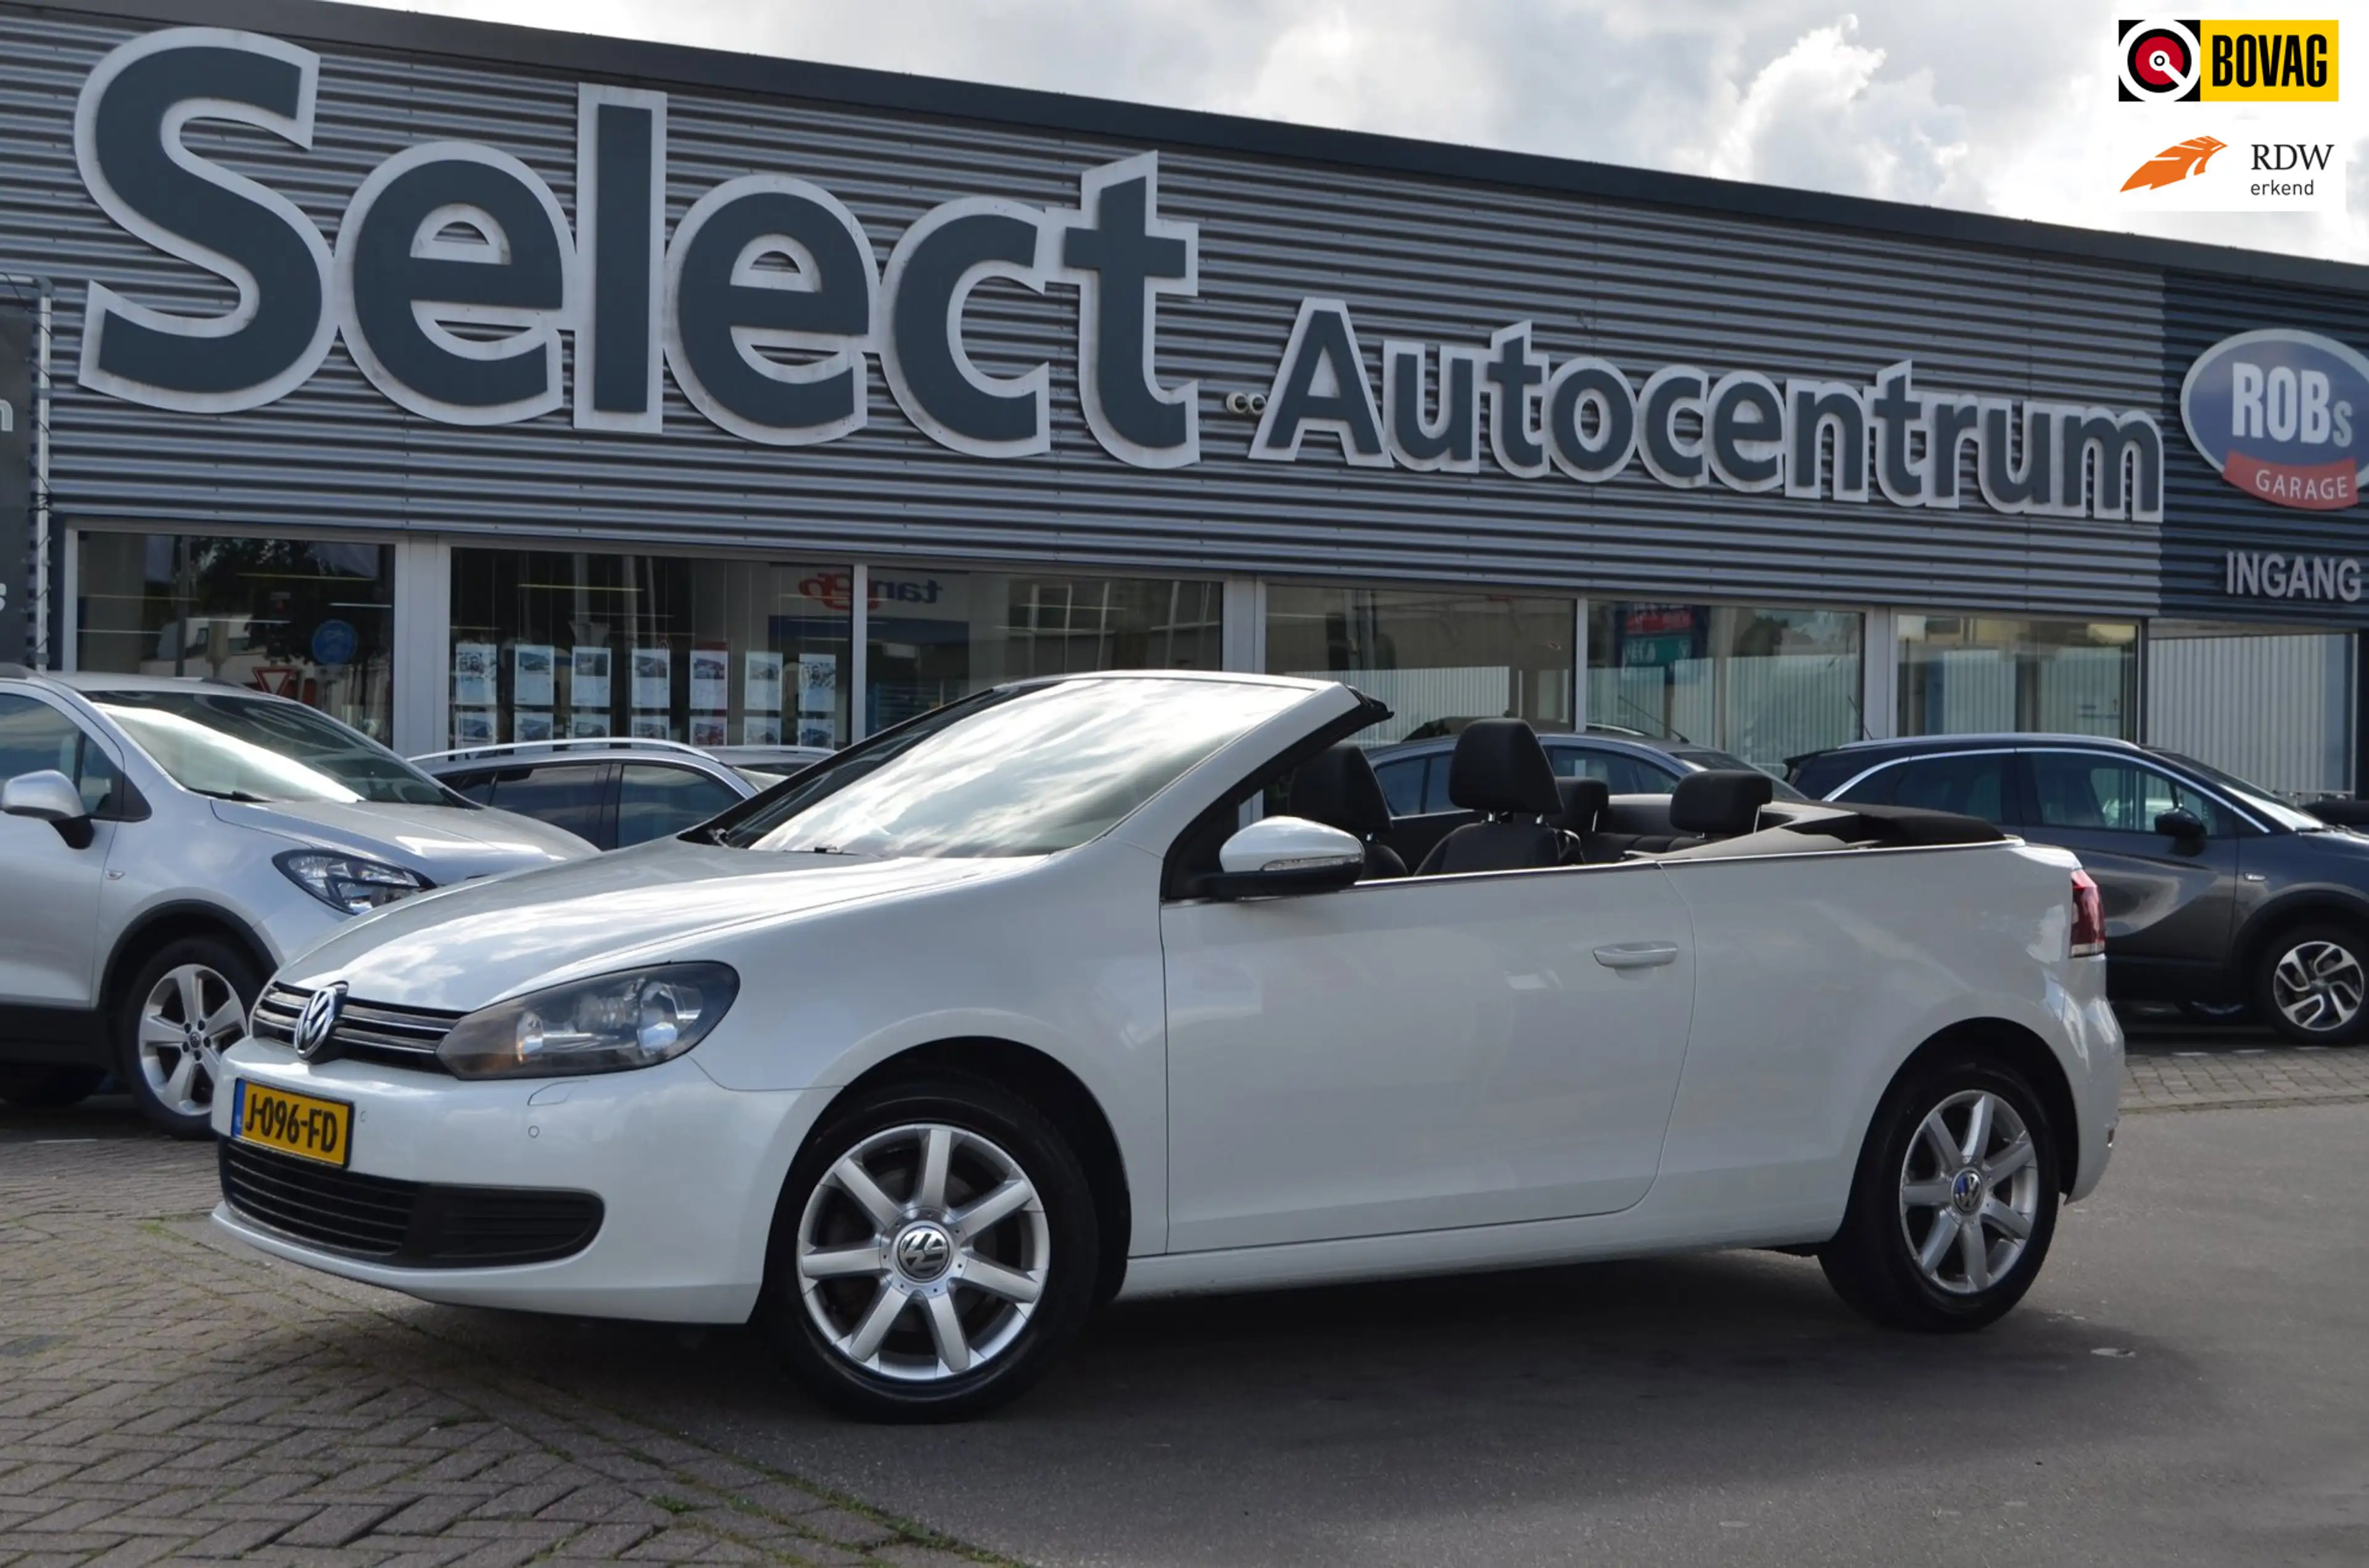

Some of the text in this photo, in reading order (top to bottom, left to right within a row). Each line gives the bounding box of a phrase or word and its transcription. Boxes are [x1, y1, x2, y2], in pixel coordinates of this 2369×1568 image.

[75, 27, 2164, 523] Select Autocentrum
[2232, 362, 2353, 448] ROBs
[2255, 469, 2348, 501] GARAGE
[2225, 550, 2362, 603] INGANG
[245, 1092, 337, 1153] J-096-FD
